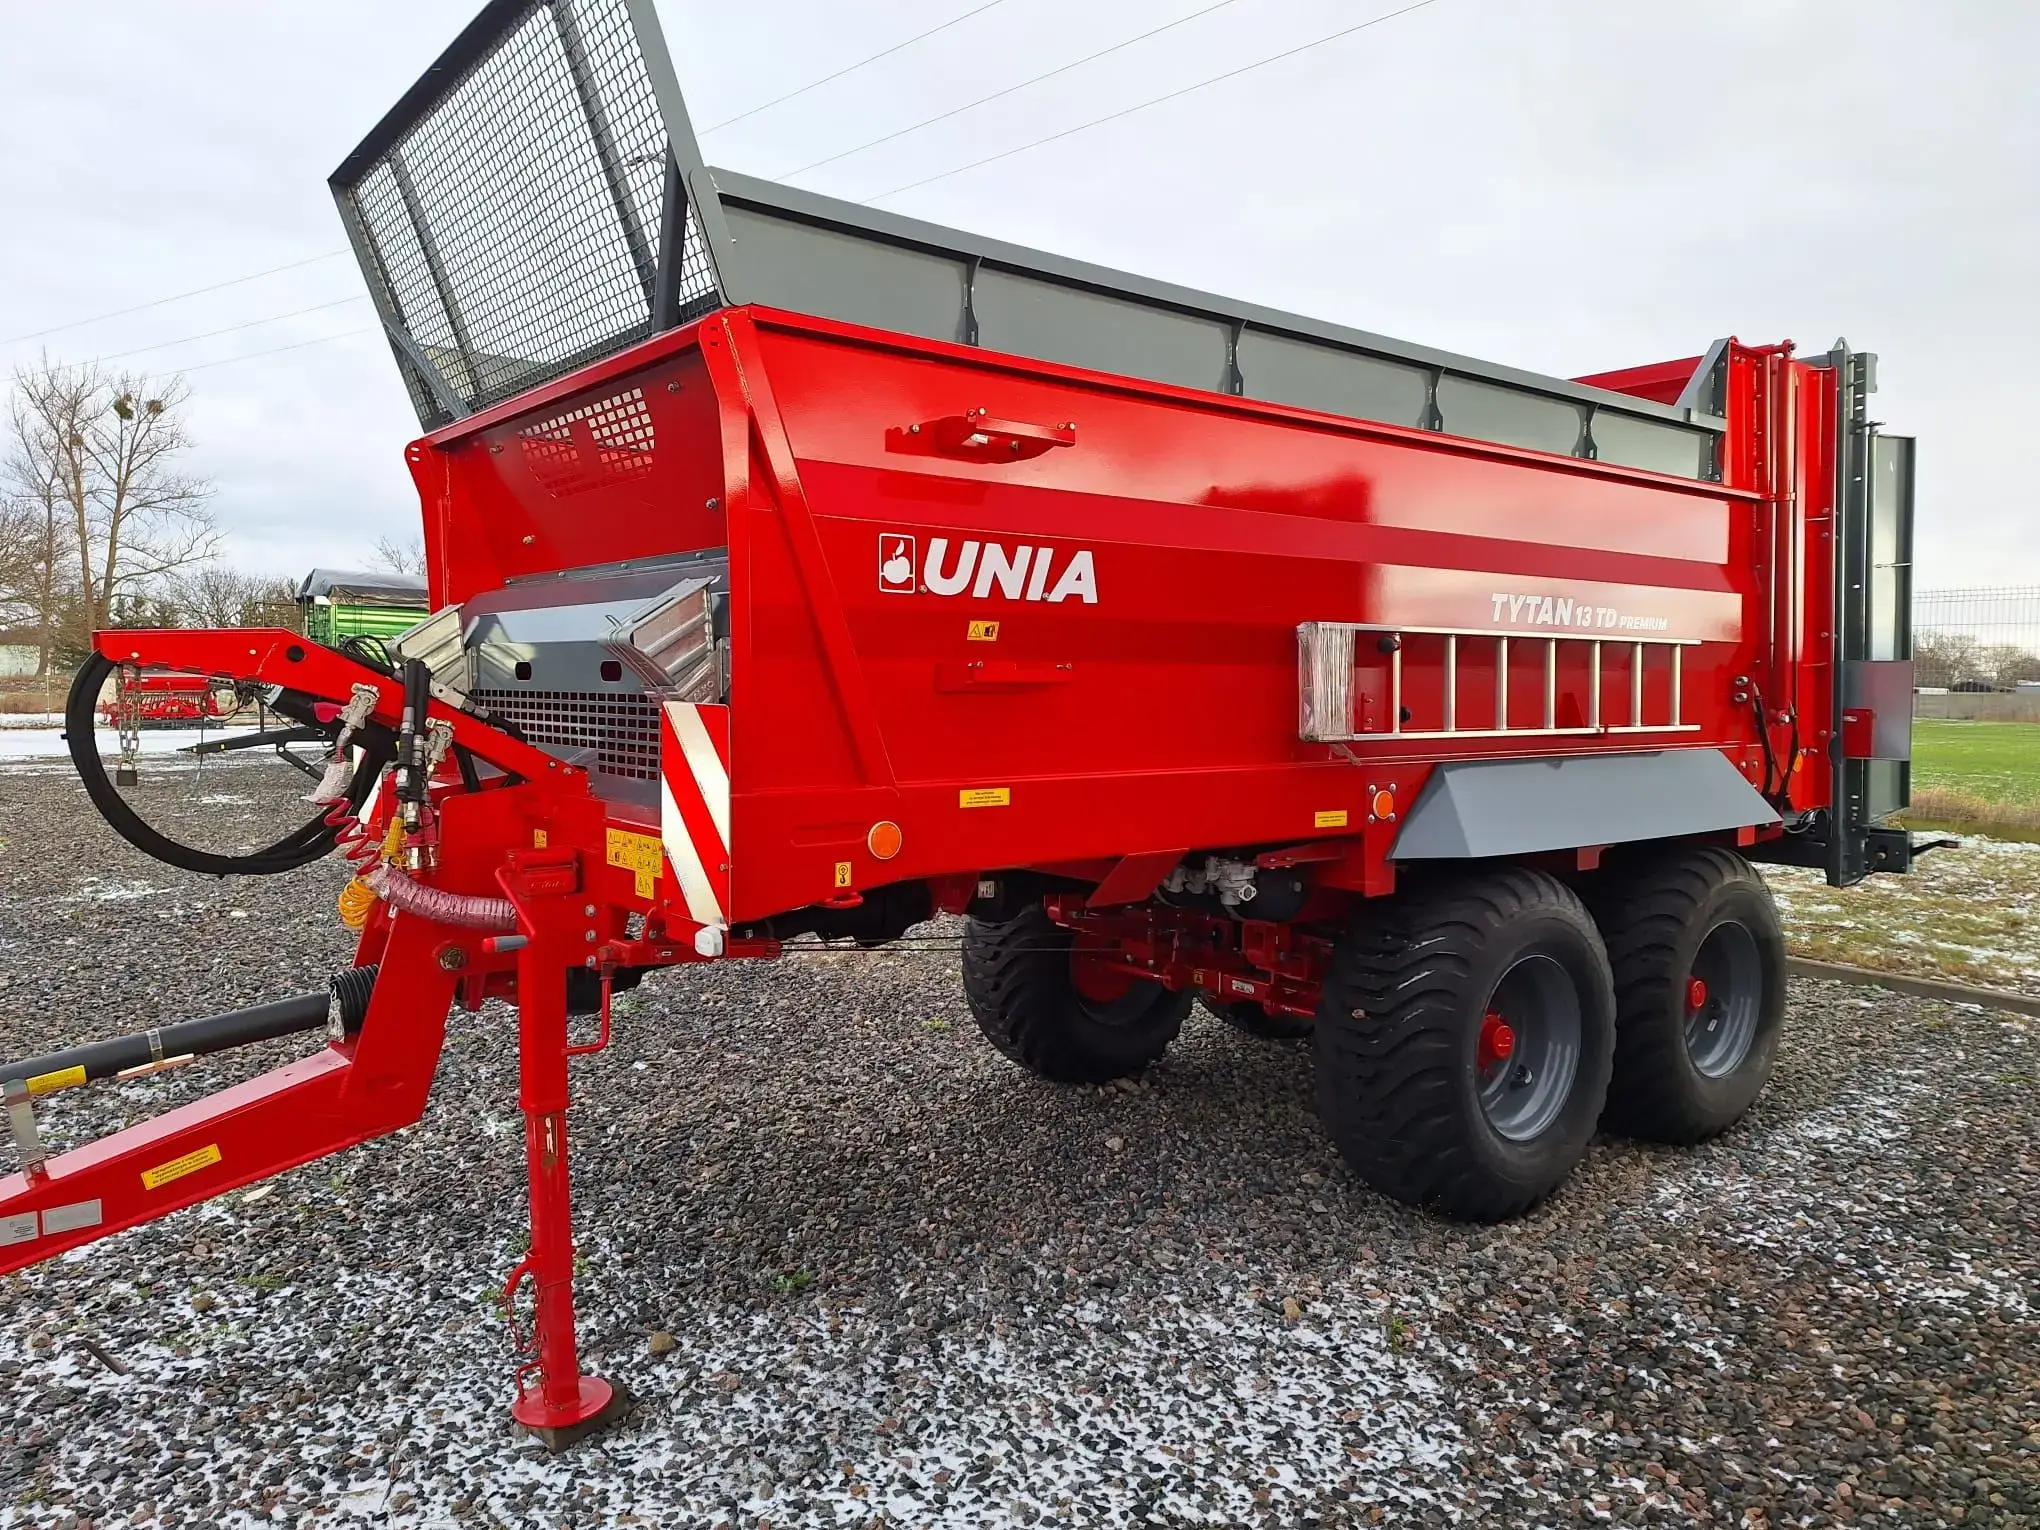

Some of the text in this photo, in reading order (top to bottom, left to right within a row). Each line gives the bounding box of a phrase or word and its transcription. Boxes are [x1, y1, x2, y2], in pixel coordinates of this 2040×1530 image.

[923, 537, 1098, 604] UNIA
[1491, 593, 1668, 631] TYTAN 13 TD PREMIUM
